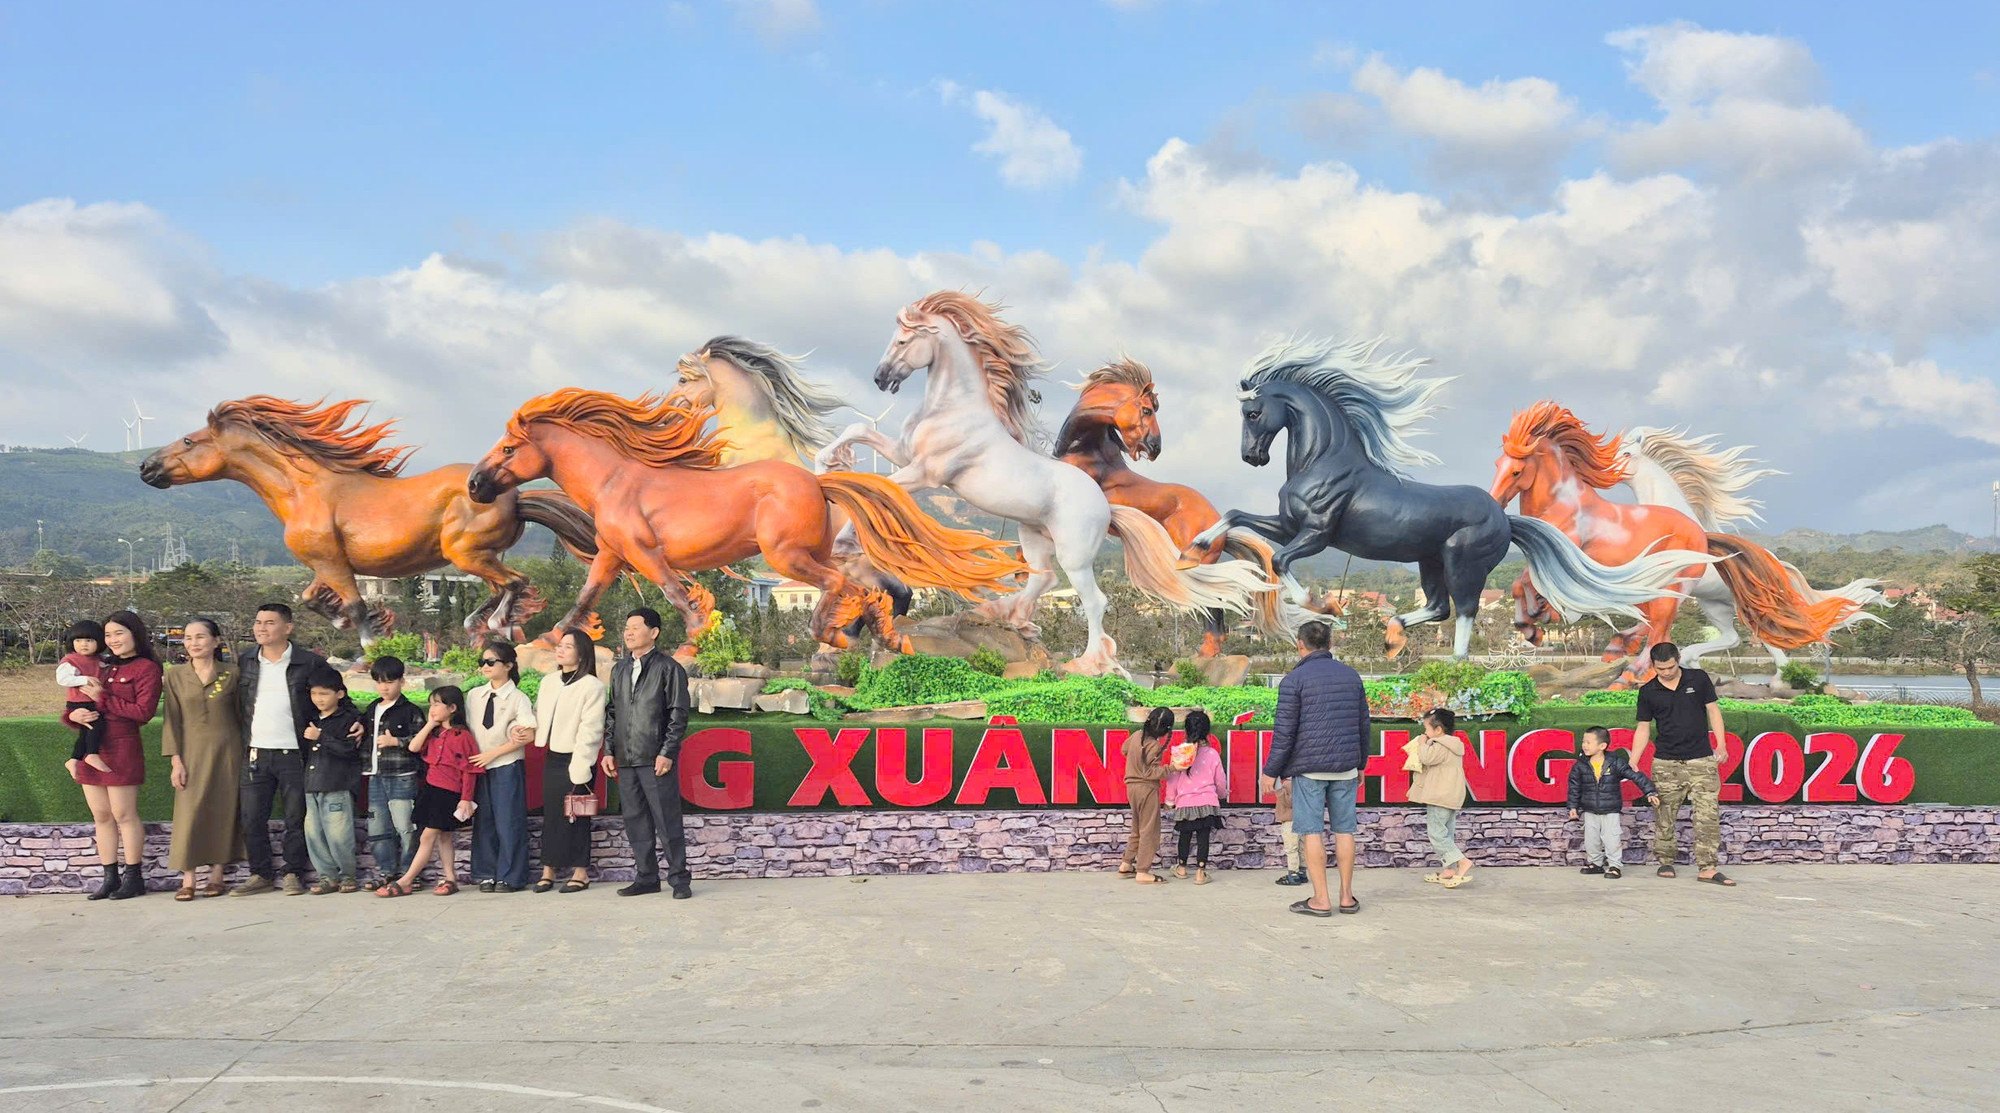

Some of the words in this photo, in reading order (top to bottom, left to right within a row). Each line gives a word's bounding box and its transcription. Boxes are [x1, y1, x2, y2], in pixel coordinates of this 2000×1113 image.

[787, 715, 1130, 805] XUÂN
[1160, 710, 1410, 804] ÍH
[1706, 731, 1915, 803] 2026
